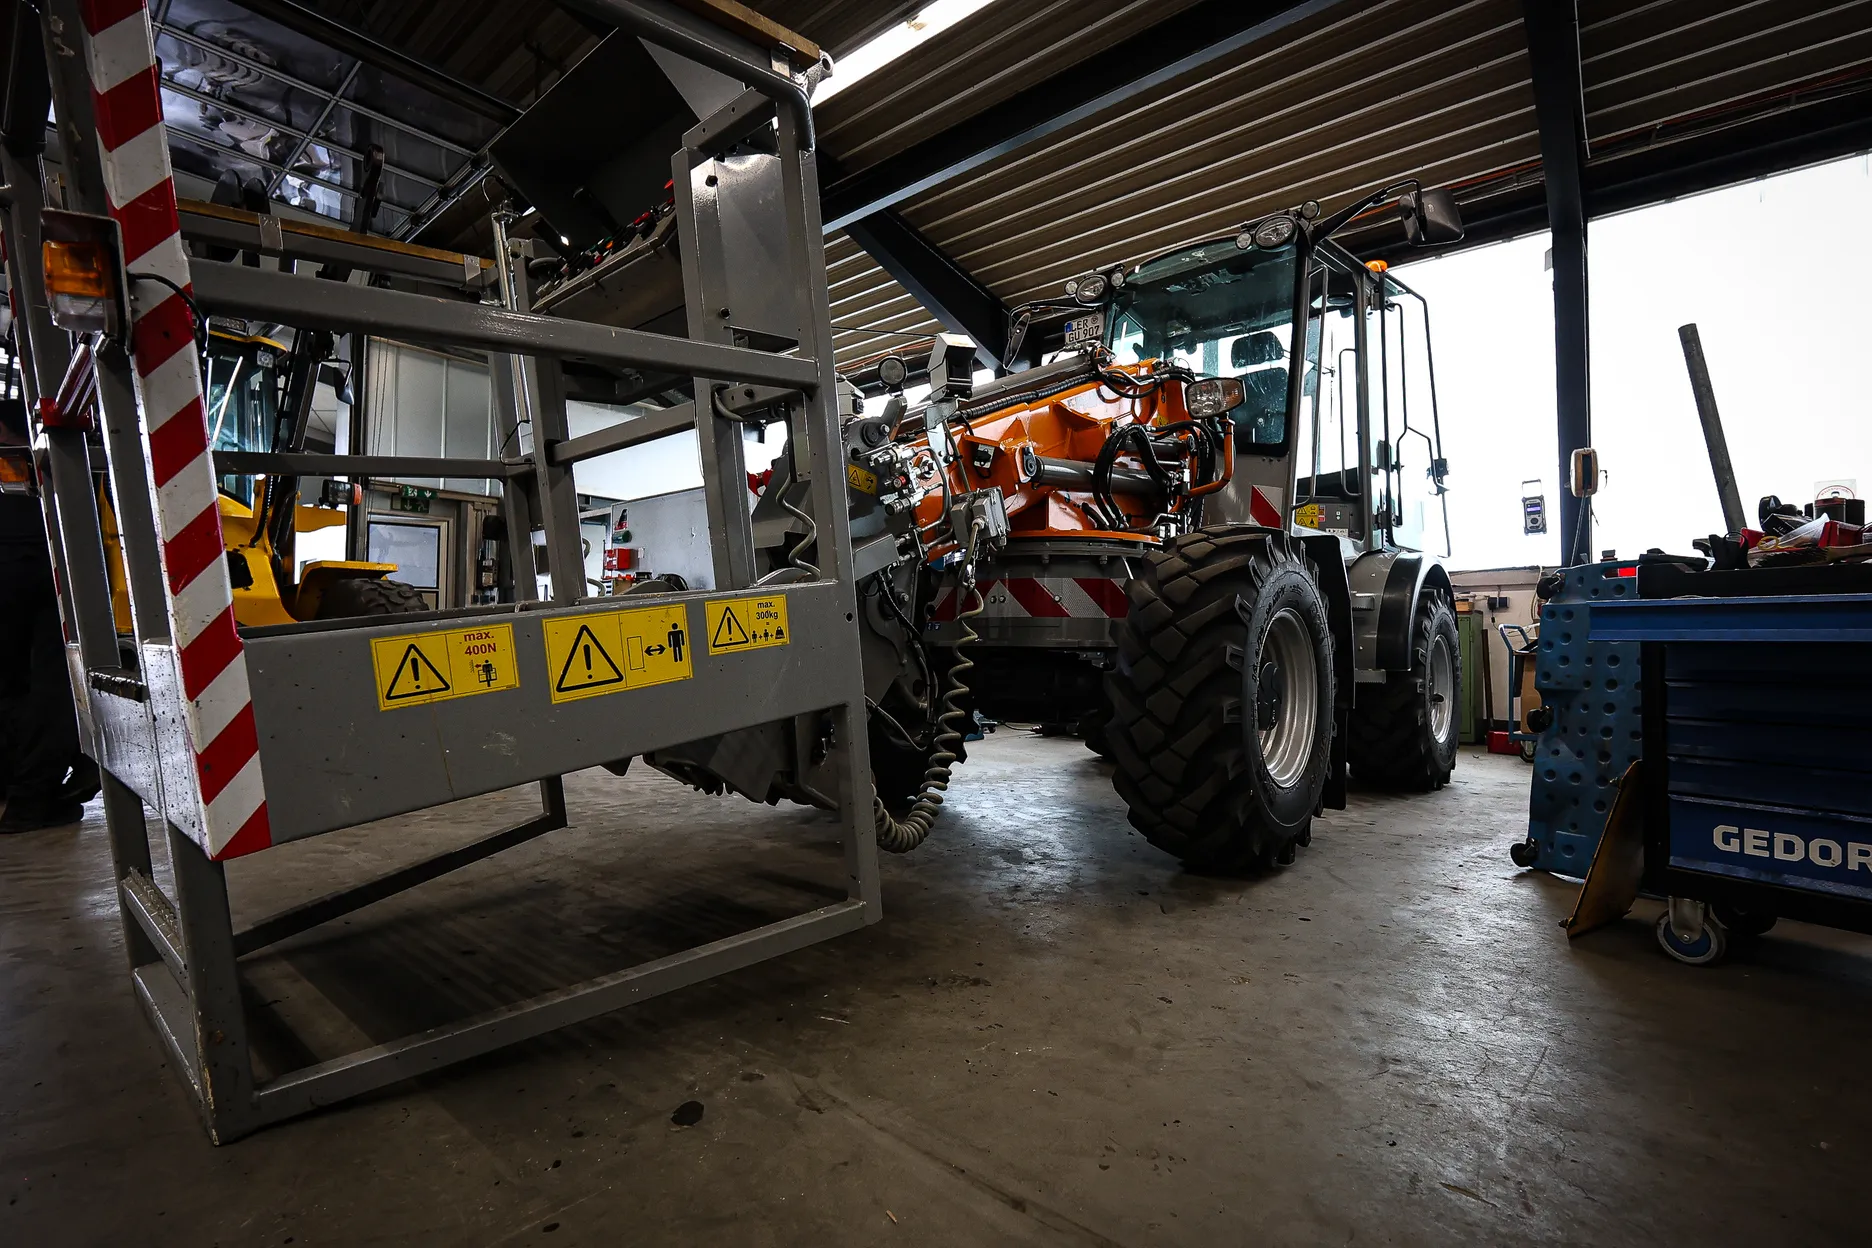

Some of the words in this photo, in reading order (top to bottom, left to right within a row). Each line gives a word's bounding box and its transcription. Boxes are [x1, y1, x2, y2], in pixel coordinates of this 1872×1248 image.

[1069, 331, 1080, 342] GU
[1083, 325, 1099, 338] 907
[757, 601, 775, 609] max.
[463, 631, 494, 642] max.
[464, 642, 497, 656] 400N
